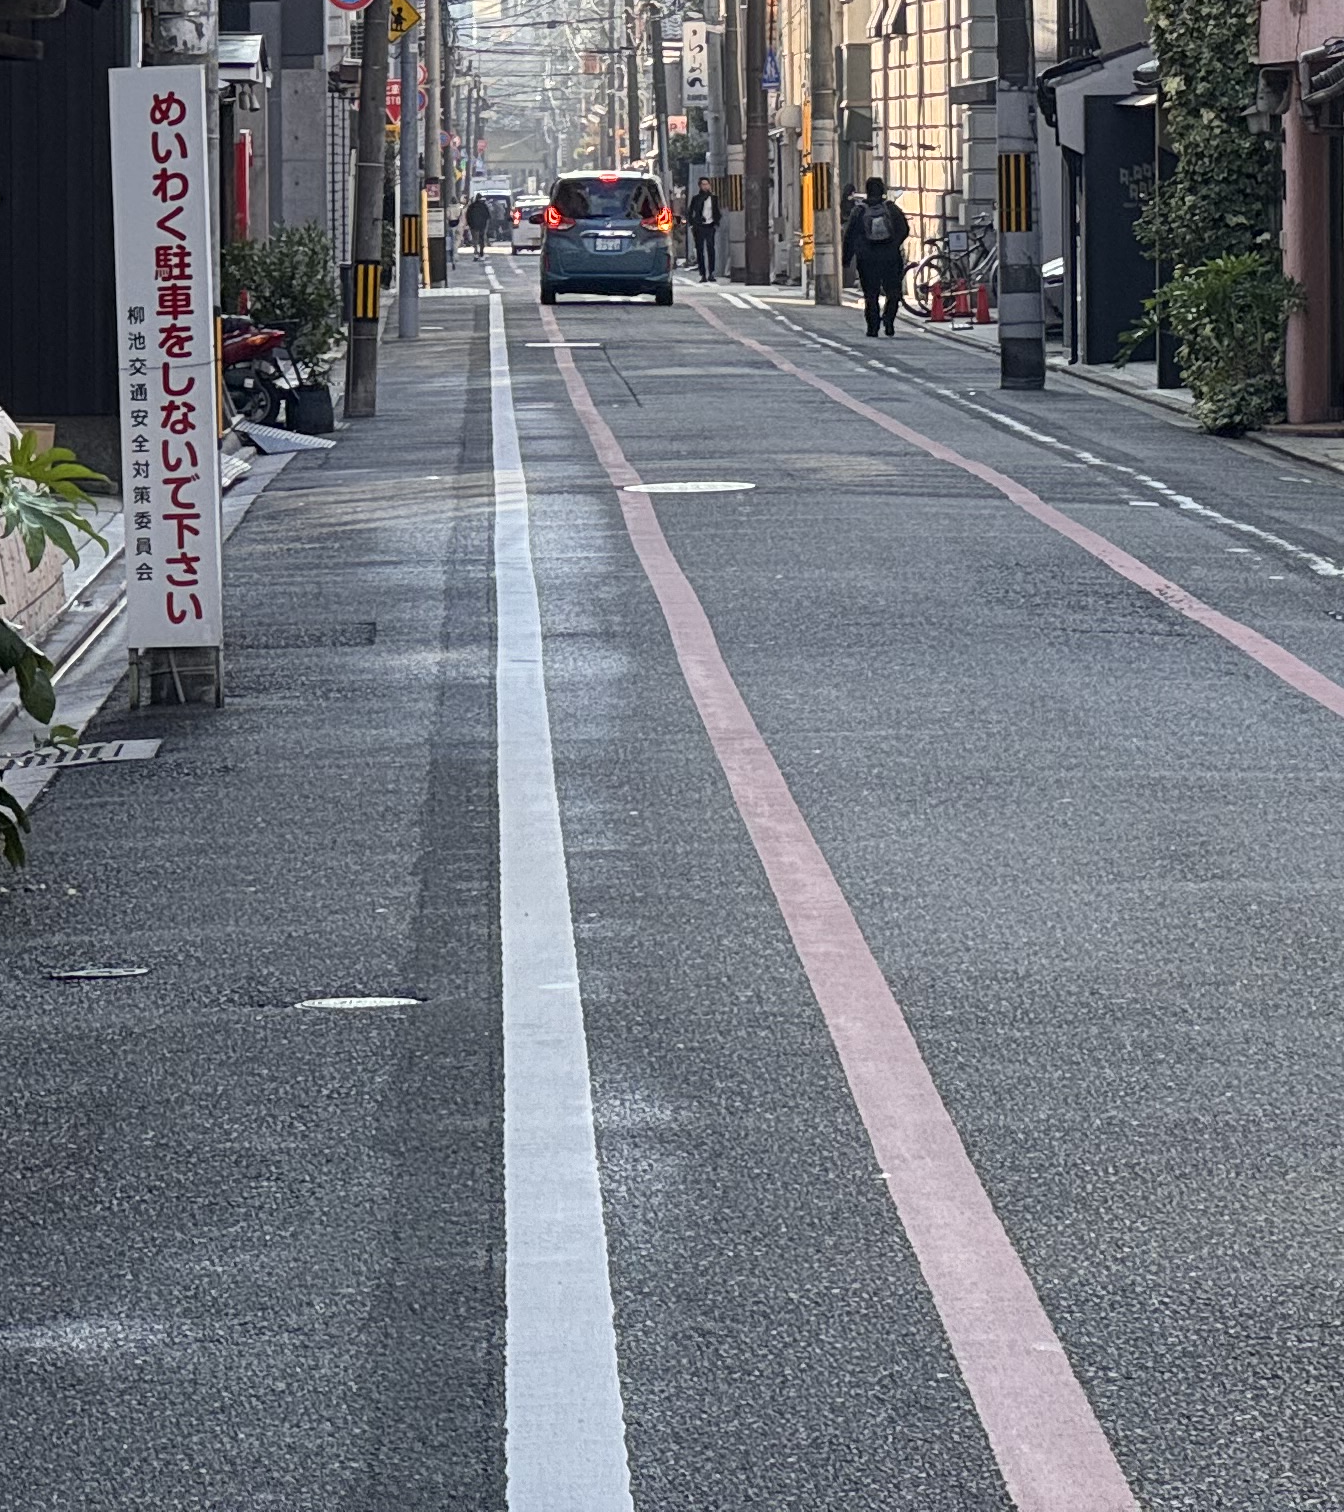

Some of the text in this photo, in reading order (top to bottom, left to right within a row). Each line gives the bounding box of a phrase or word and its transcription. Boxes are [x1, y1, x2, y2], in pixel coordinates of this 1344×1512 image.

[385, 96, 402, 106] STO
[127, 305, 154, 583] 柳池交通安全対策委員会
[149, 91, 204, 626] めいわく駐車をしないで下さい
